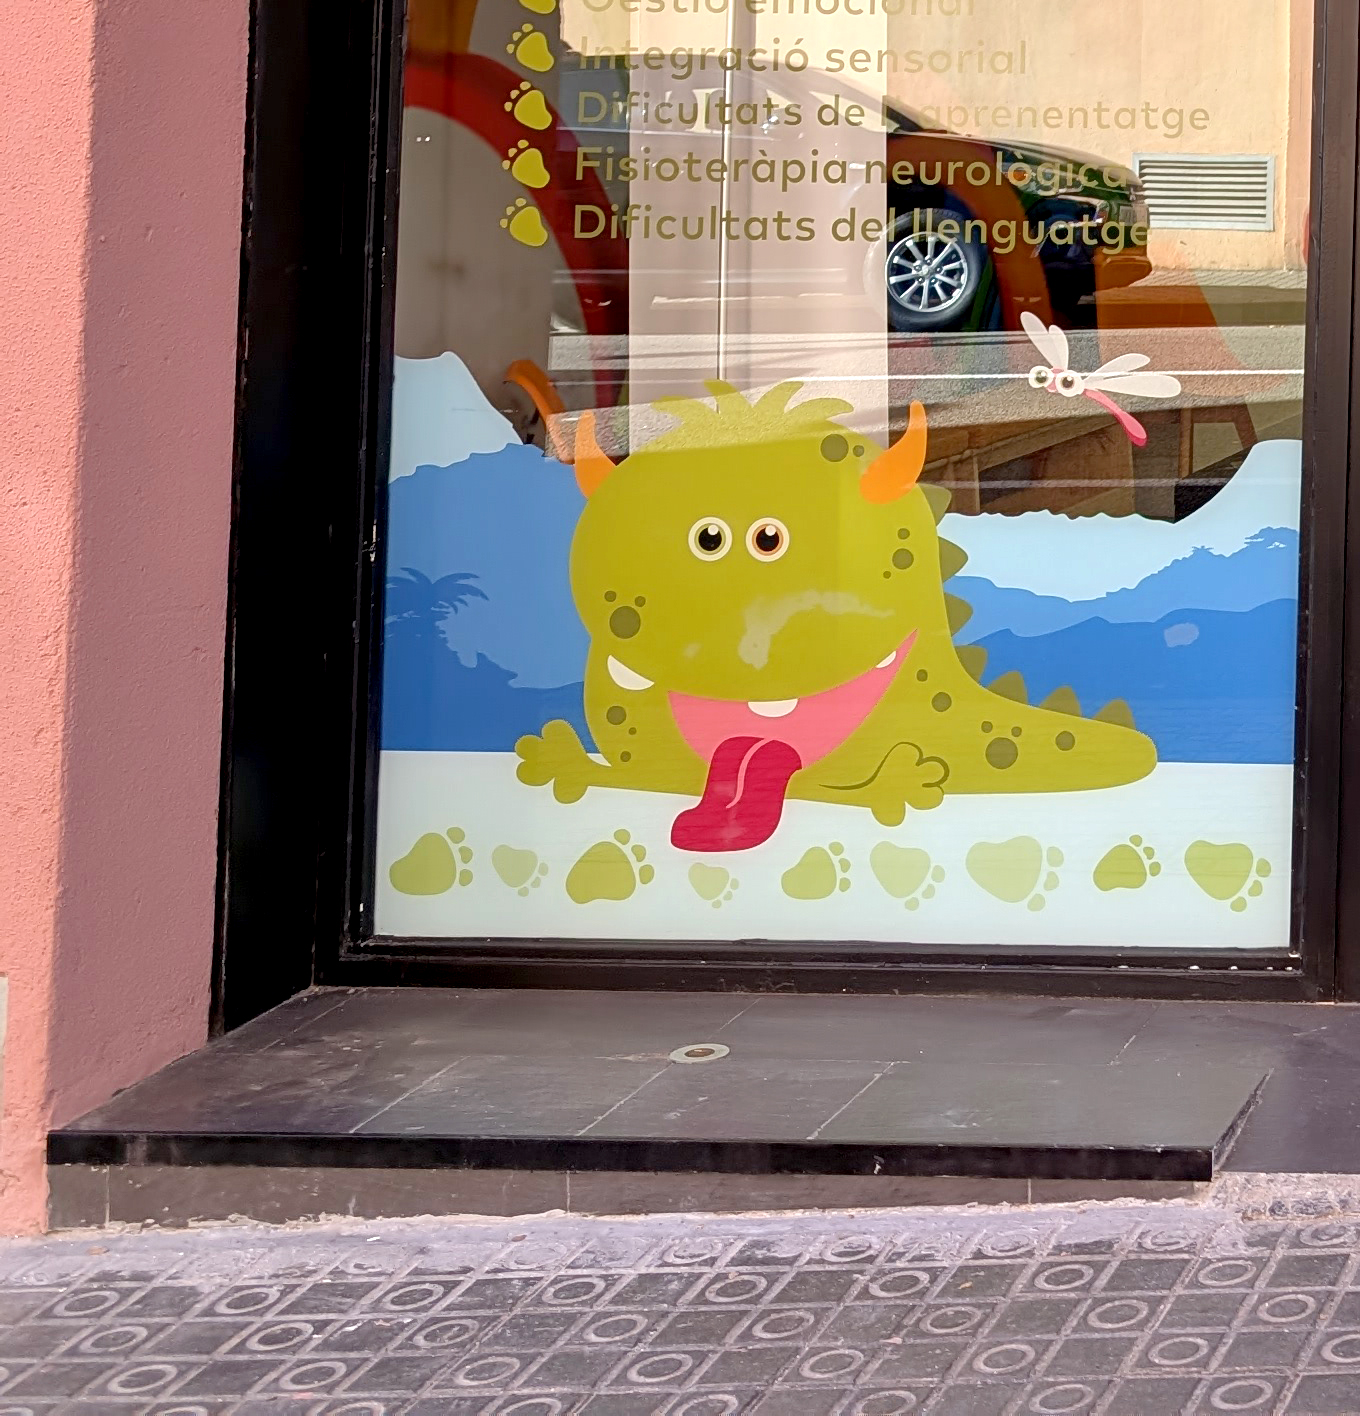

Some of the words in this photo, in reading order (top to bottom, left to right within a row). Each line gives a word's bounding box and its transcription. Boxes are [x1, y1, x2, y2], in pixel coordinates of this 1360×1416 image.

[579, 36, 809, 80] Integració
[825, 40, 1027, 72] sensorial
[577, 90, 803, 127] Dificultats
[816, 93, 866, 127] de
[575, 146, 848, 192] Fisioteràpia
[864, 150, 1130, 197] neurològica
[573, 204, 816, 242] Dificultats
[831, 206, 894, 243] del
[911, 207, 1153, 255] llenguatge
